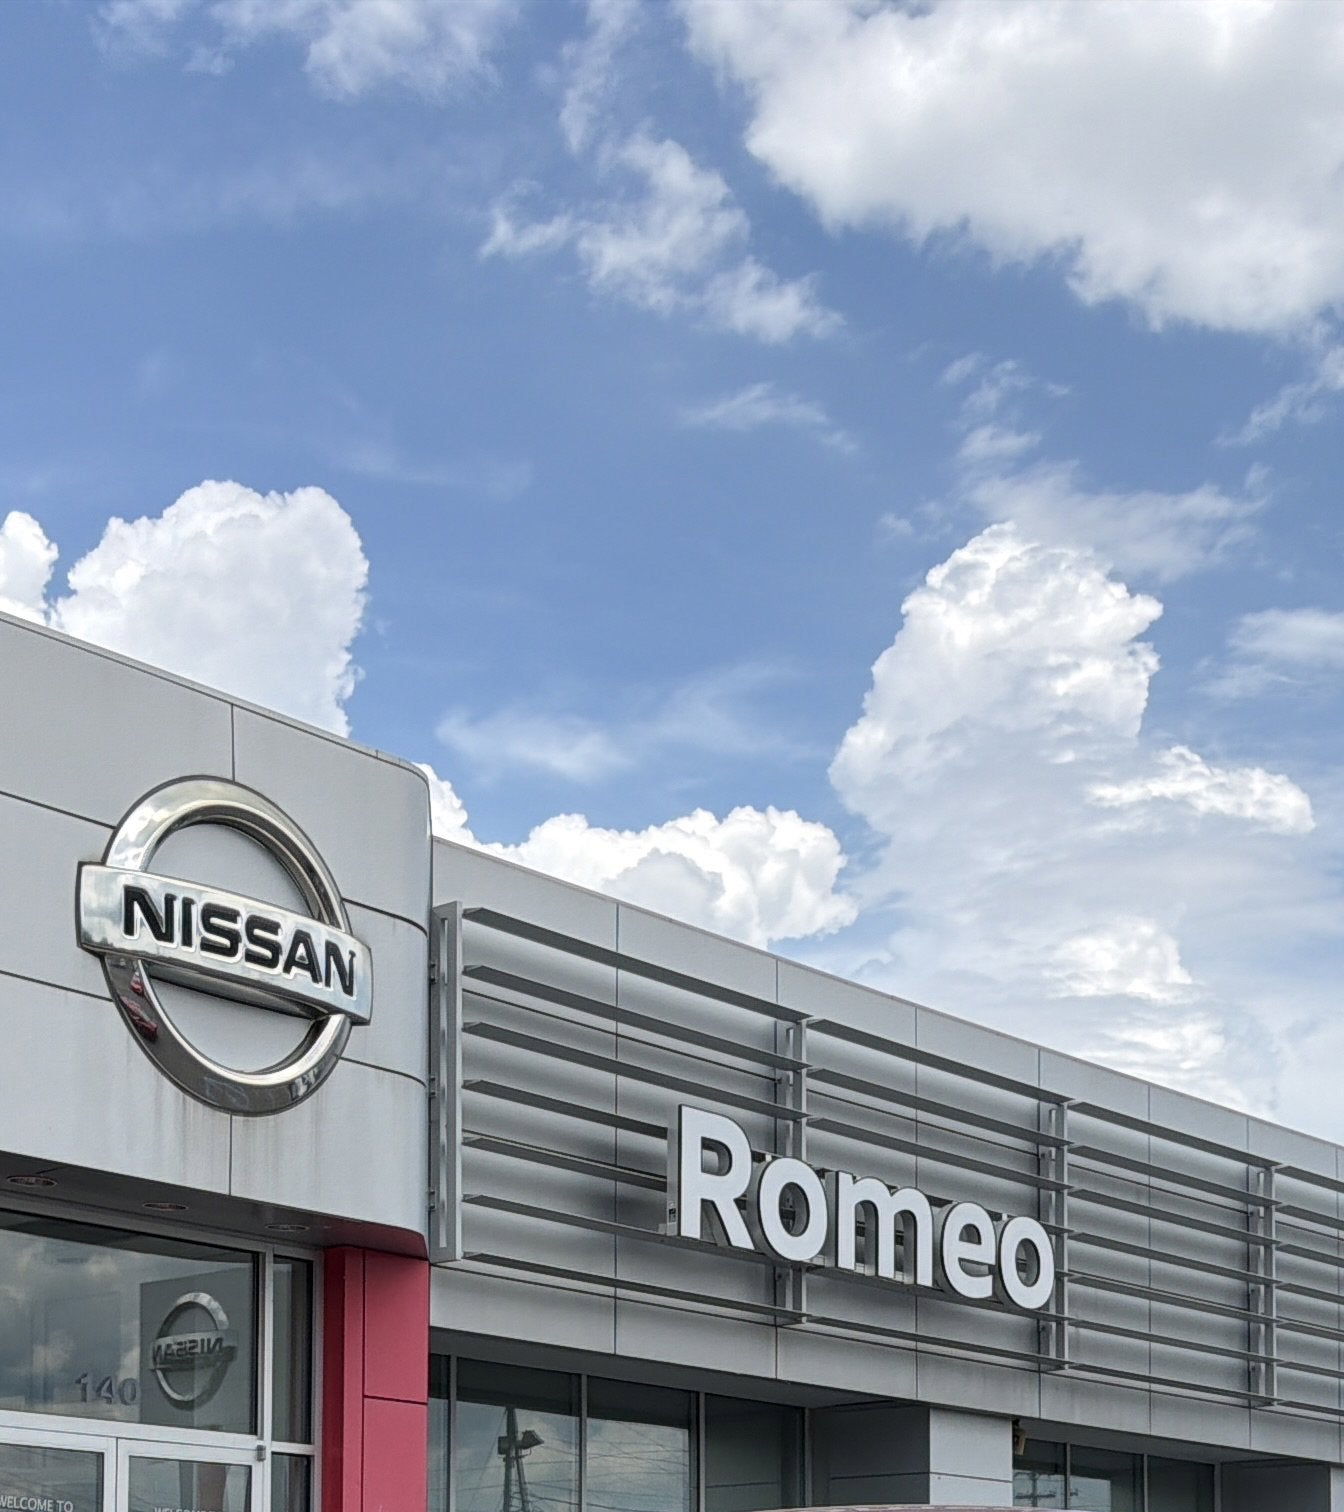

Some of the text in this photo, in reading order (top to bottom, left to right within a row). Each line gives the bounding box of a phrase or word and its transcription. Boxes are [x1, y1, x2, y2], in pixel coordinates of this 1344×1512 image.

[122, 884, 357, 997] NISSAN
[678, 1103, 1055, 1310] Romeo
[75, 1371, 138, 1406] 140
